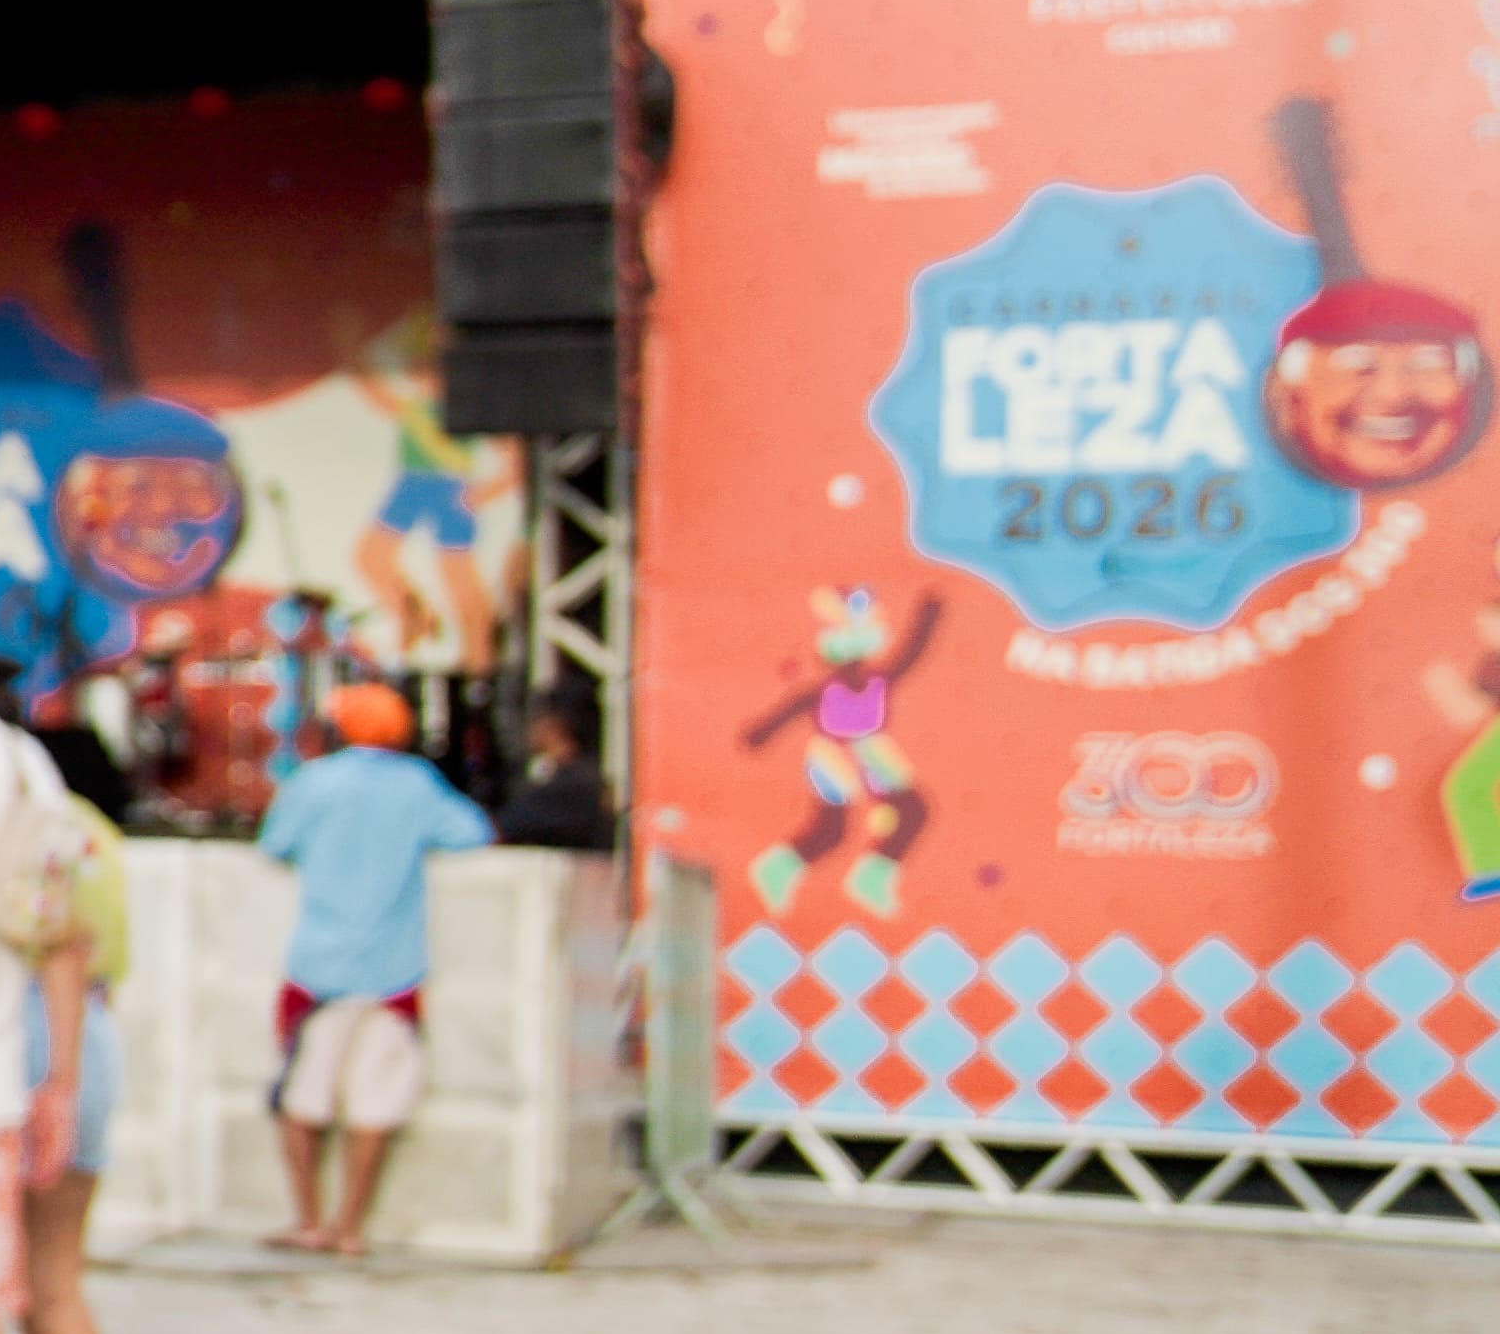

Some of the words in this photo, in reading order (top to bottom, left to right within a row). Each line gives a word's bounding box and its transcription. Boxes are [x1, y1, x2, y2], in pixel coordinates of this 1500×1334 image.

[940, 319, 1247, 391] FORTA
[940, 375, 1252, 475] LEZA
[998, 475, 1248, 543] 2026
